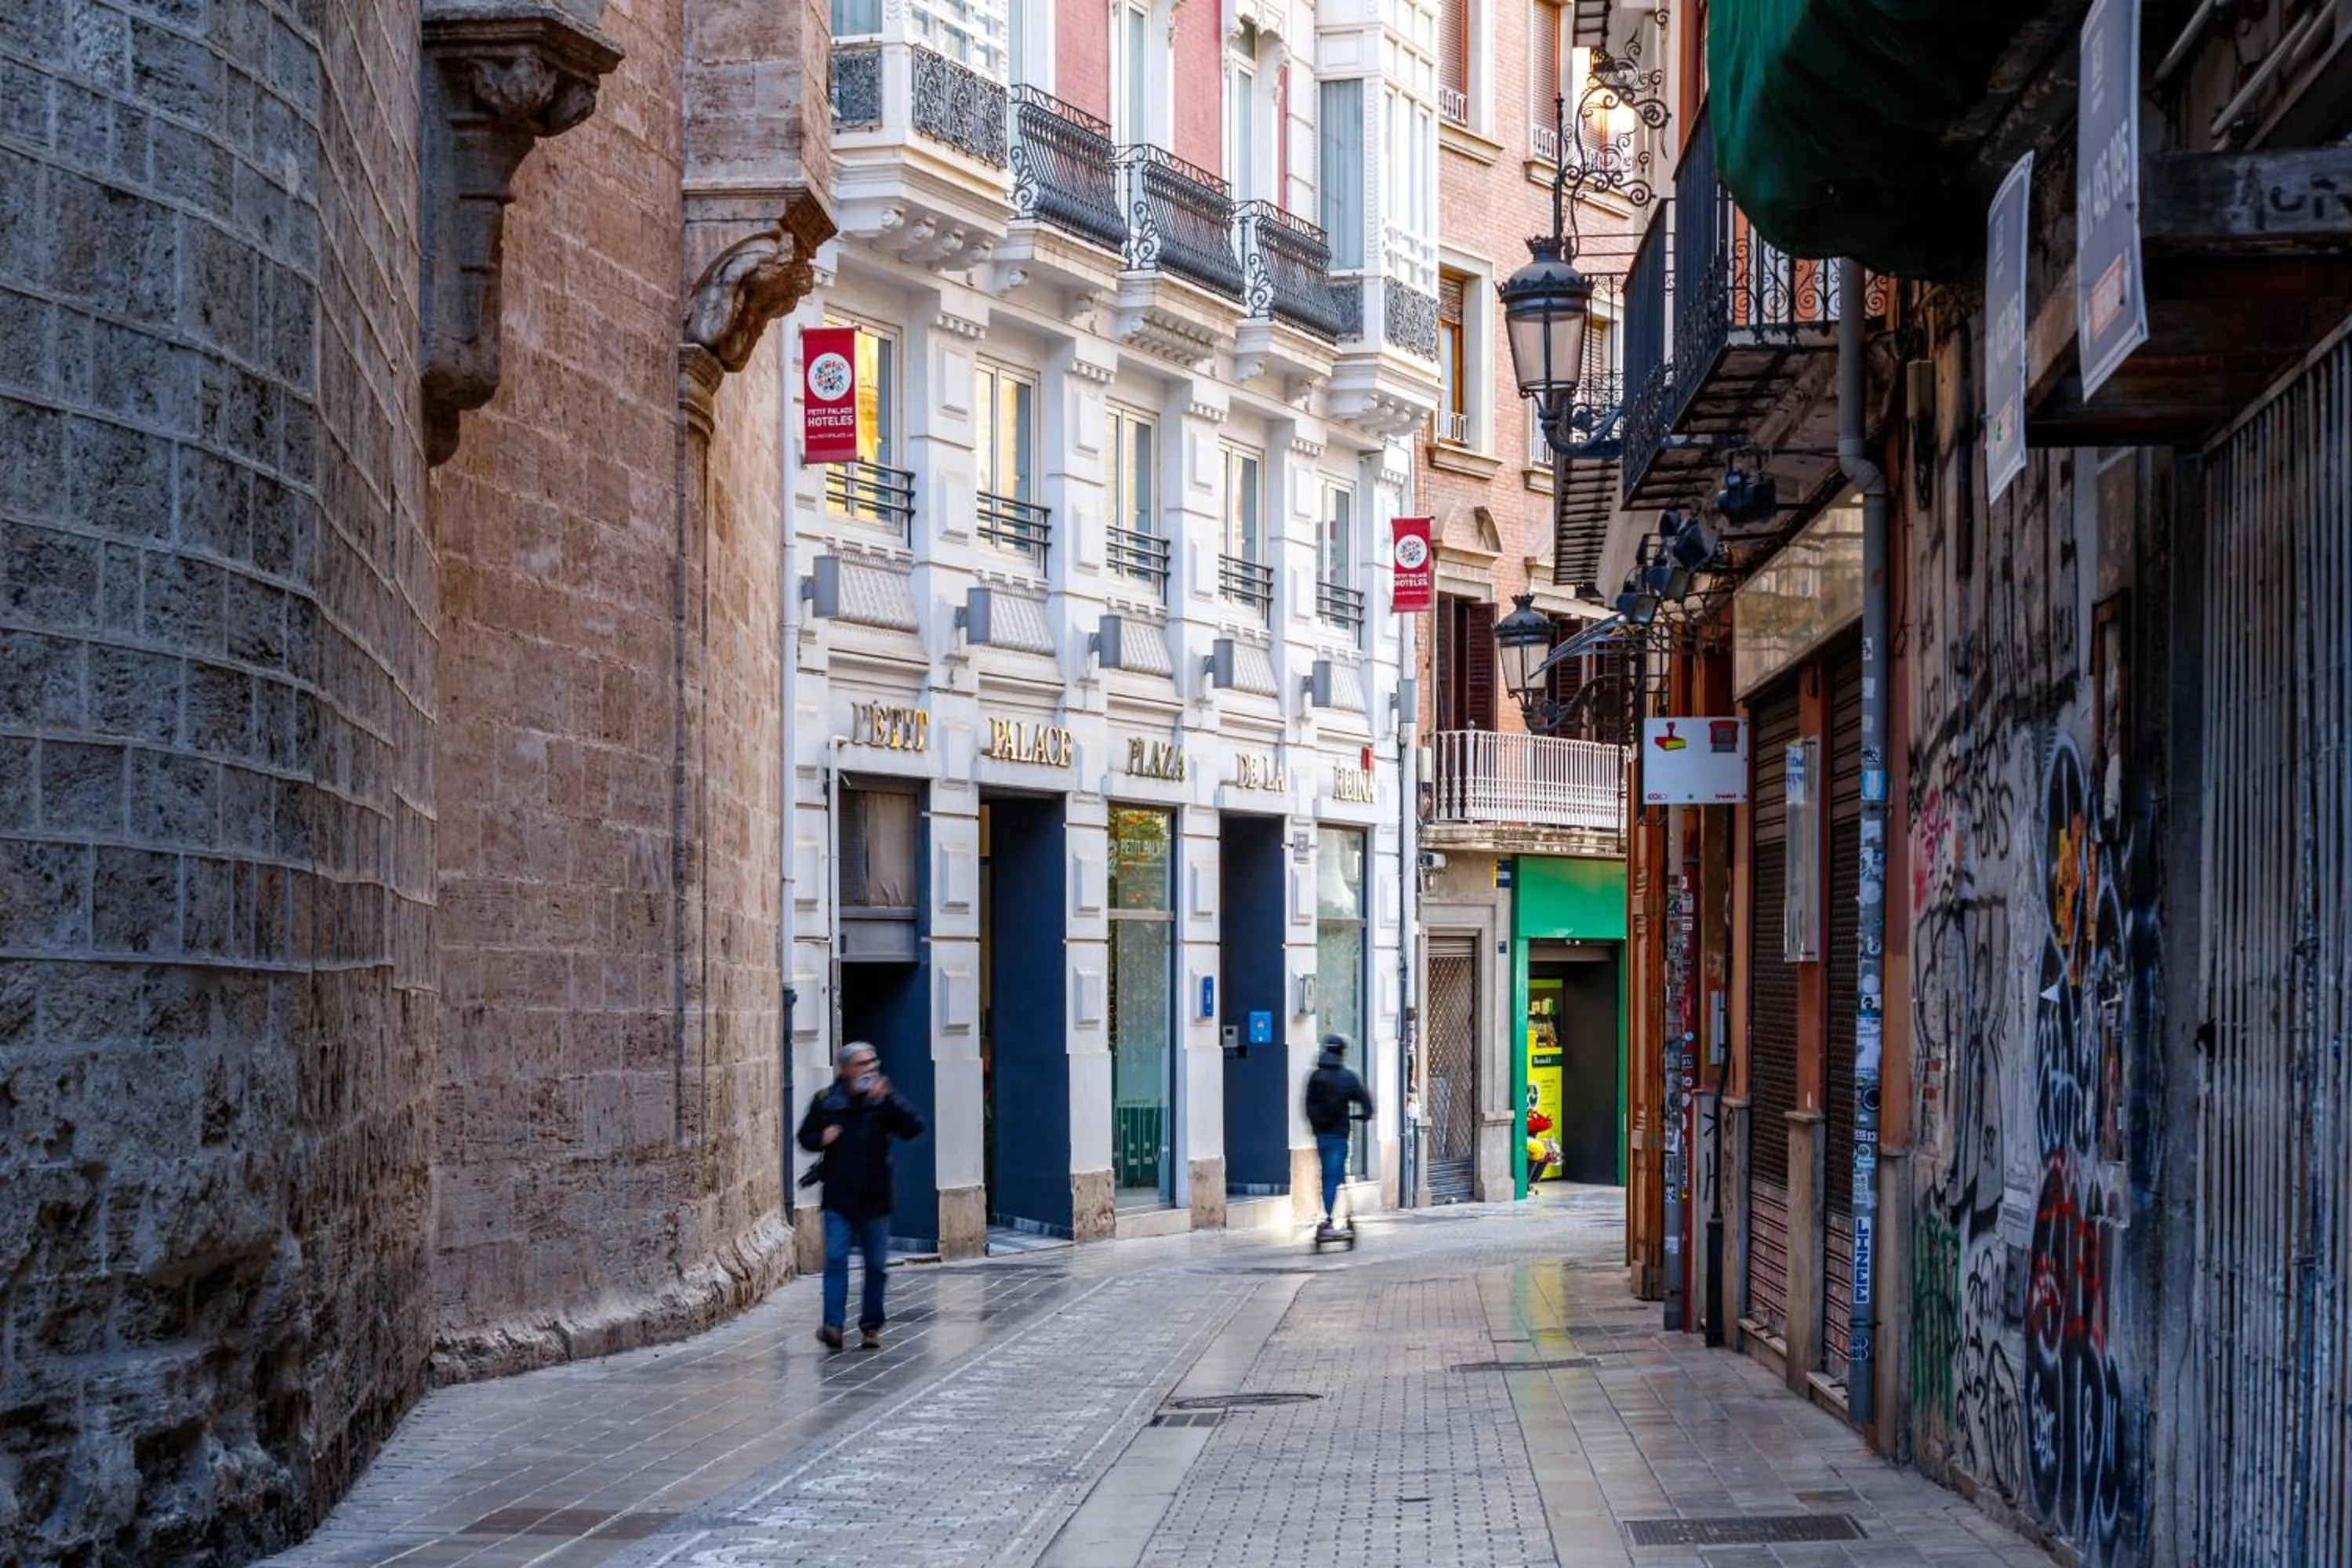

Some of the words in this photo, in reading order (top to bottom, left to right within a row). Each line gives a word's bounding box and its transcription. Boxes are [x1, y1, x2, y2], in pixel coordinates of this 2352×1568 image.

[808, 416, 854, 427] HOTELES
[1394, 579, 1428, 587] HOTELES
[851, 702, 929, 752] PETIT
[990, 716, 1073, 767] PALACE
[1127, 737, 1185, 782] PLAZA
[1236, 753, 1258, 790] DE
[1262, 755, 1285, 793] LA
[1333, 764, 1377, 804] REINA
